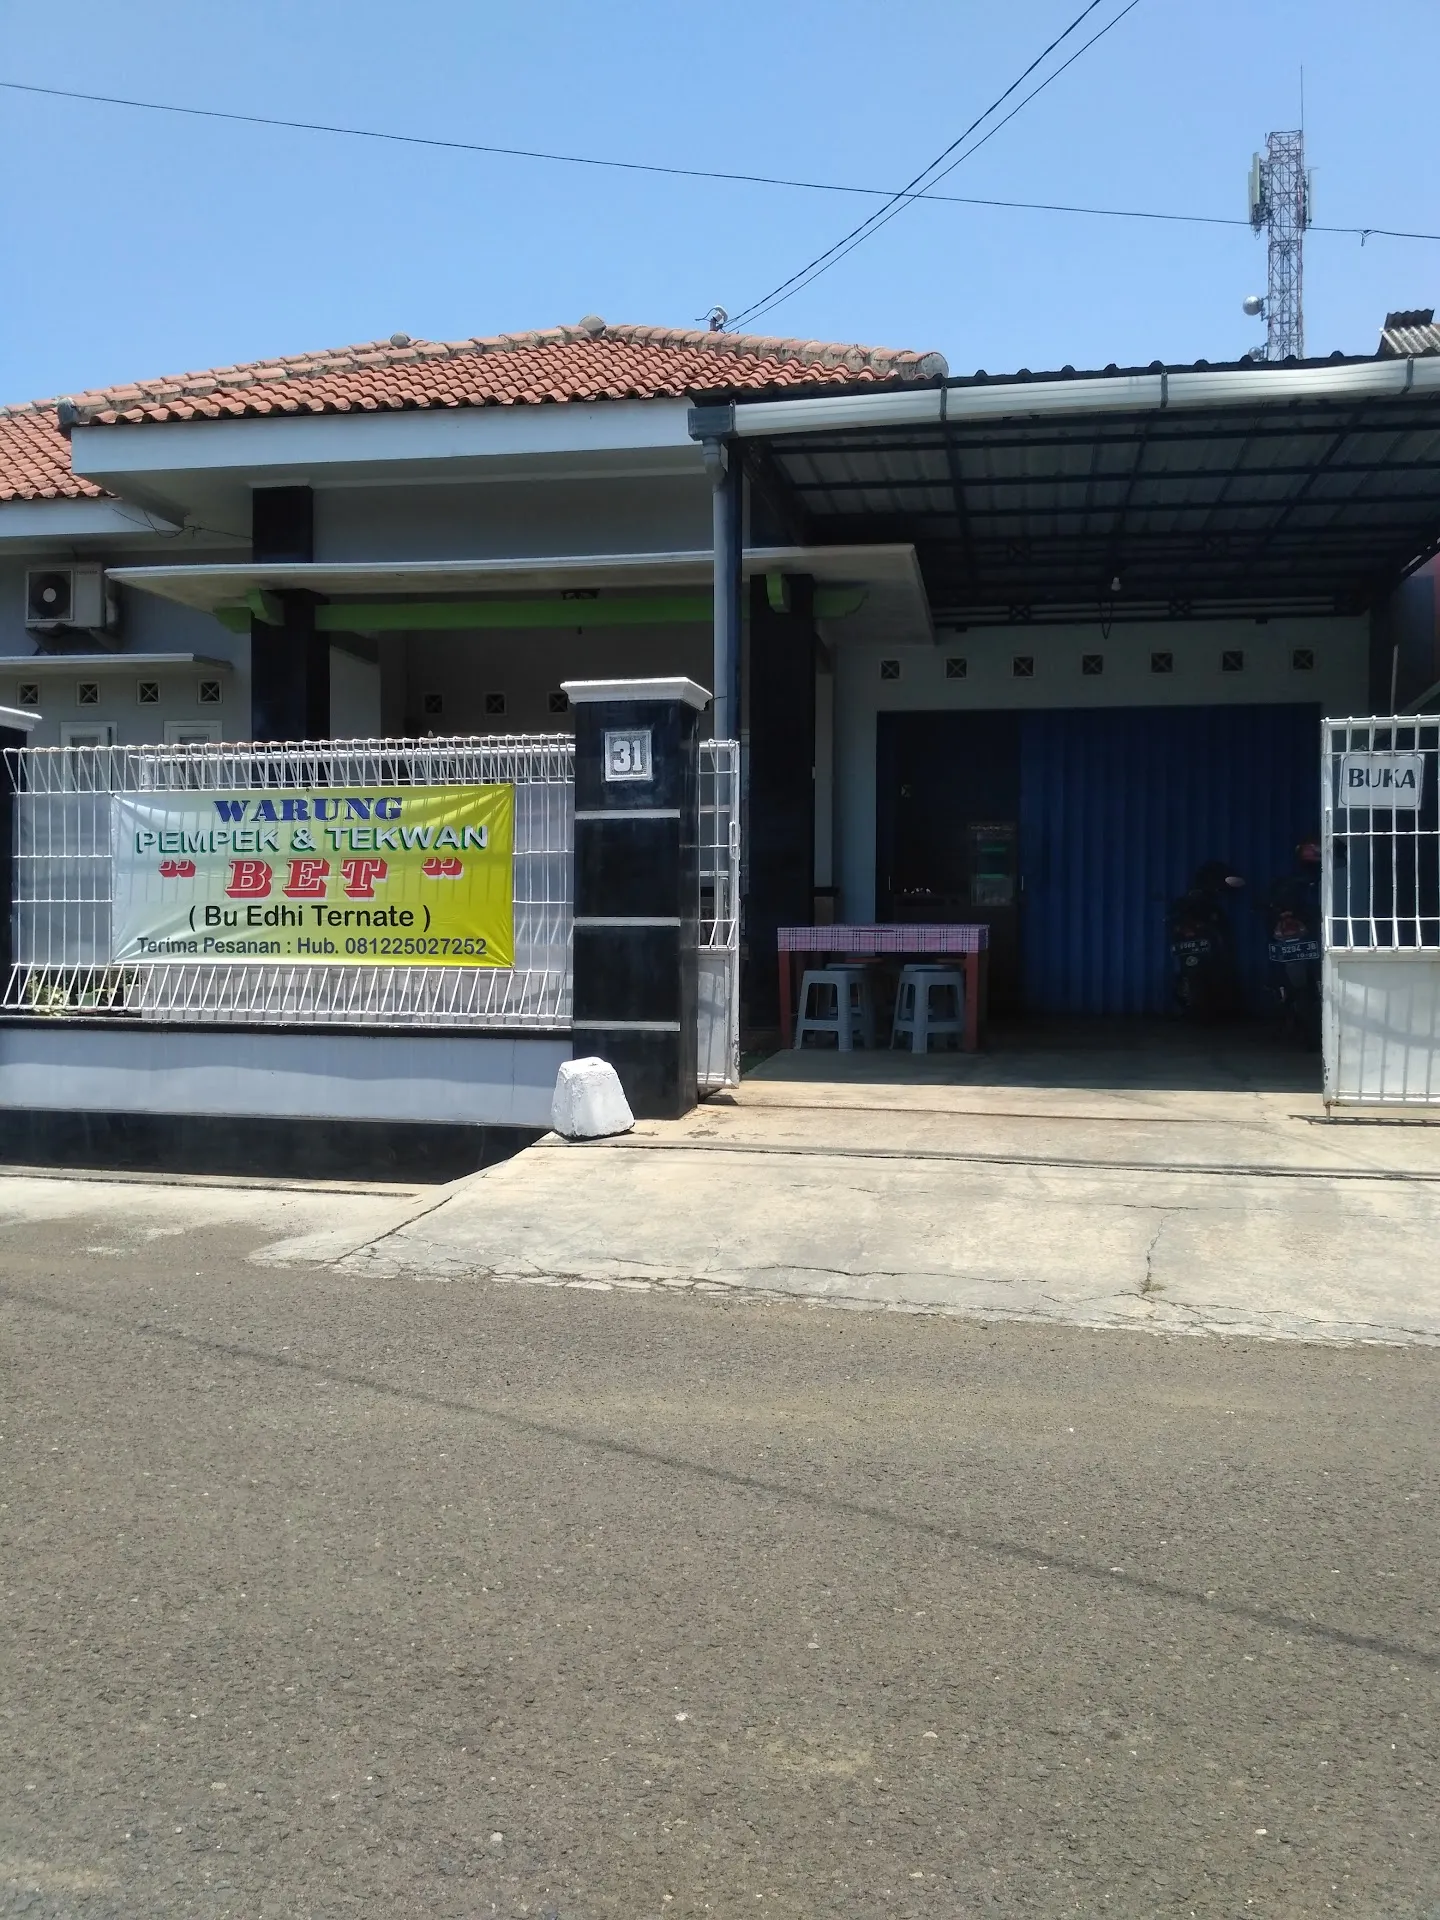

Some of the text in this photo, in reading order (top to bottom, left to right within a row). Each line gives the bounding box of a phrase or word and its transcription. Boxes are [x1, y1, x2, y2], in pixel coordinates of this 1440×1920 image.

[613, 740, 642, 771] 31
[1348, 768, 1416, 788] BUKA
[213, 796, 402, 823] WARUNG
[135, 826, 489, 854] PEMPEK & TEKWAN
[246, 904, 303, 927] Edhi
[137, 937, 198, 954] Terima
[203, 937, 281, 954] Pesanan
[297, 937, 339, 955] Hub.
[345, 937, 488, 955] 081225027252
